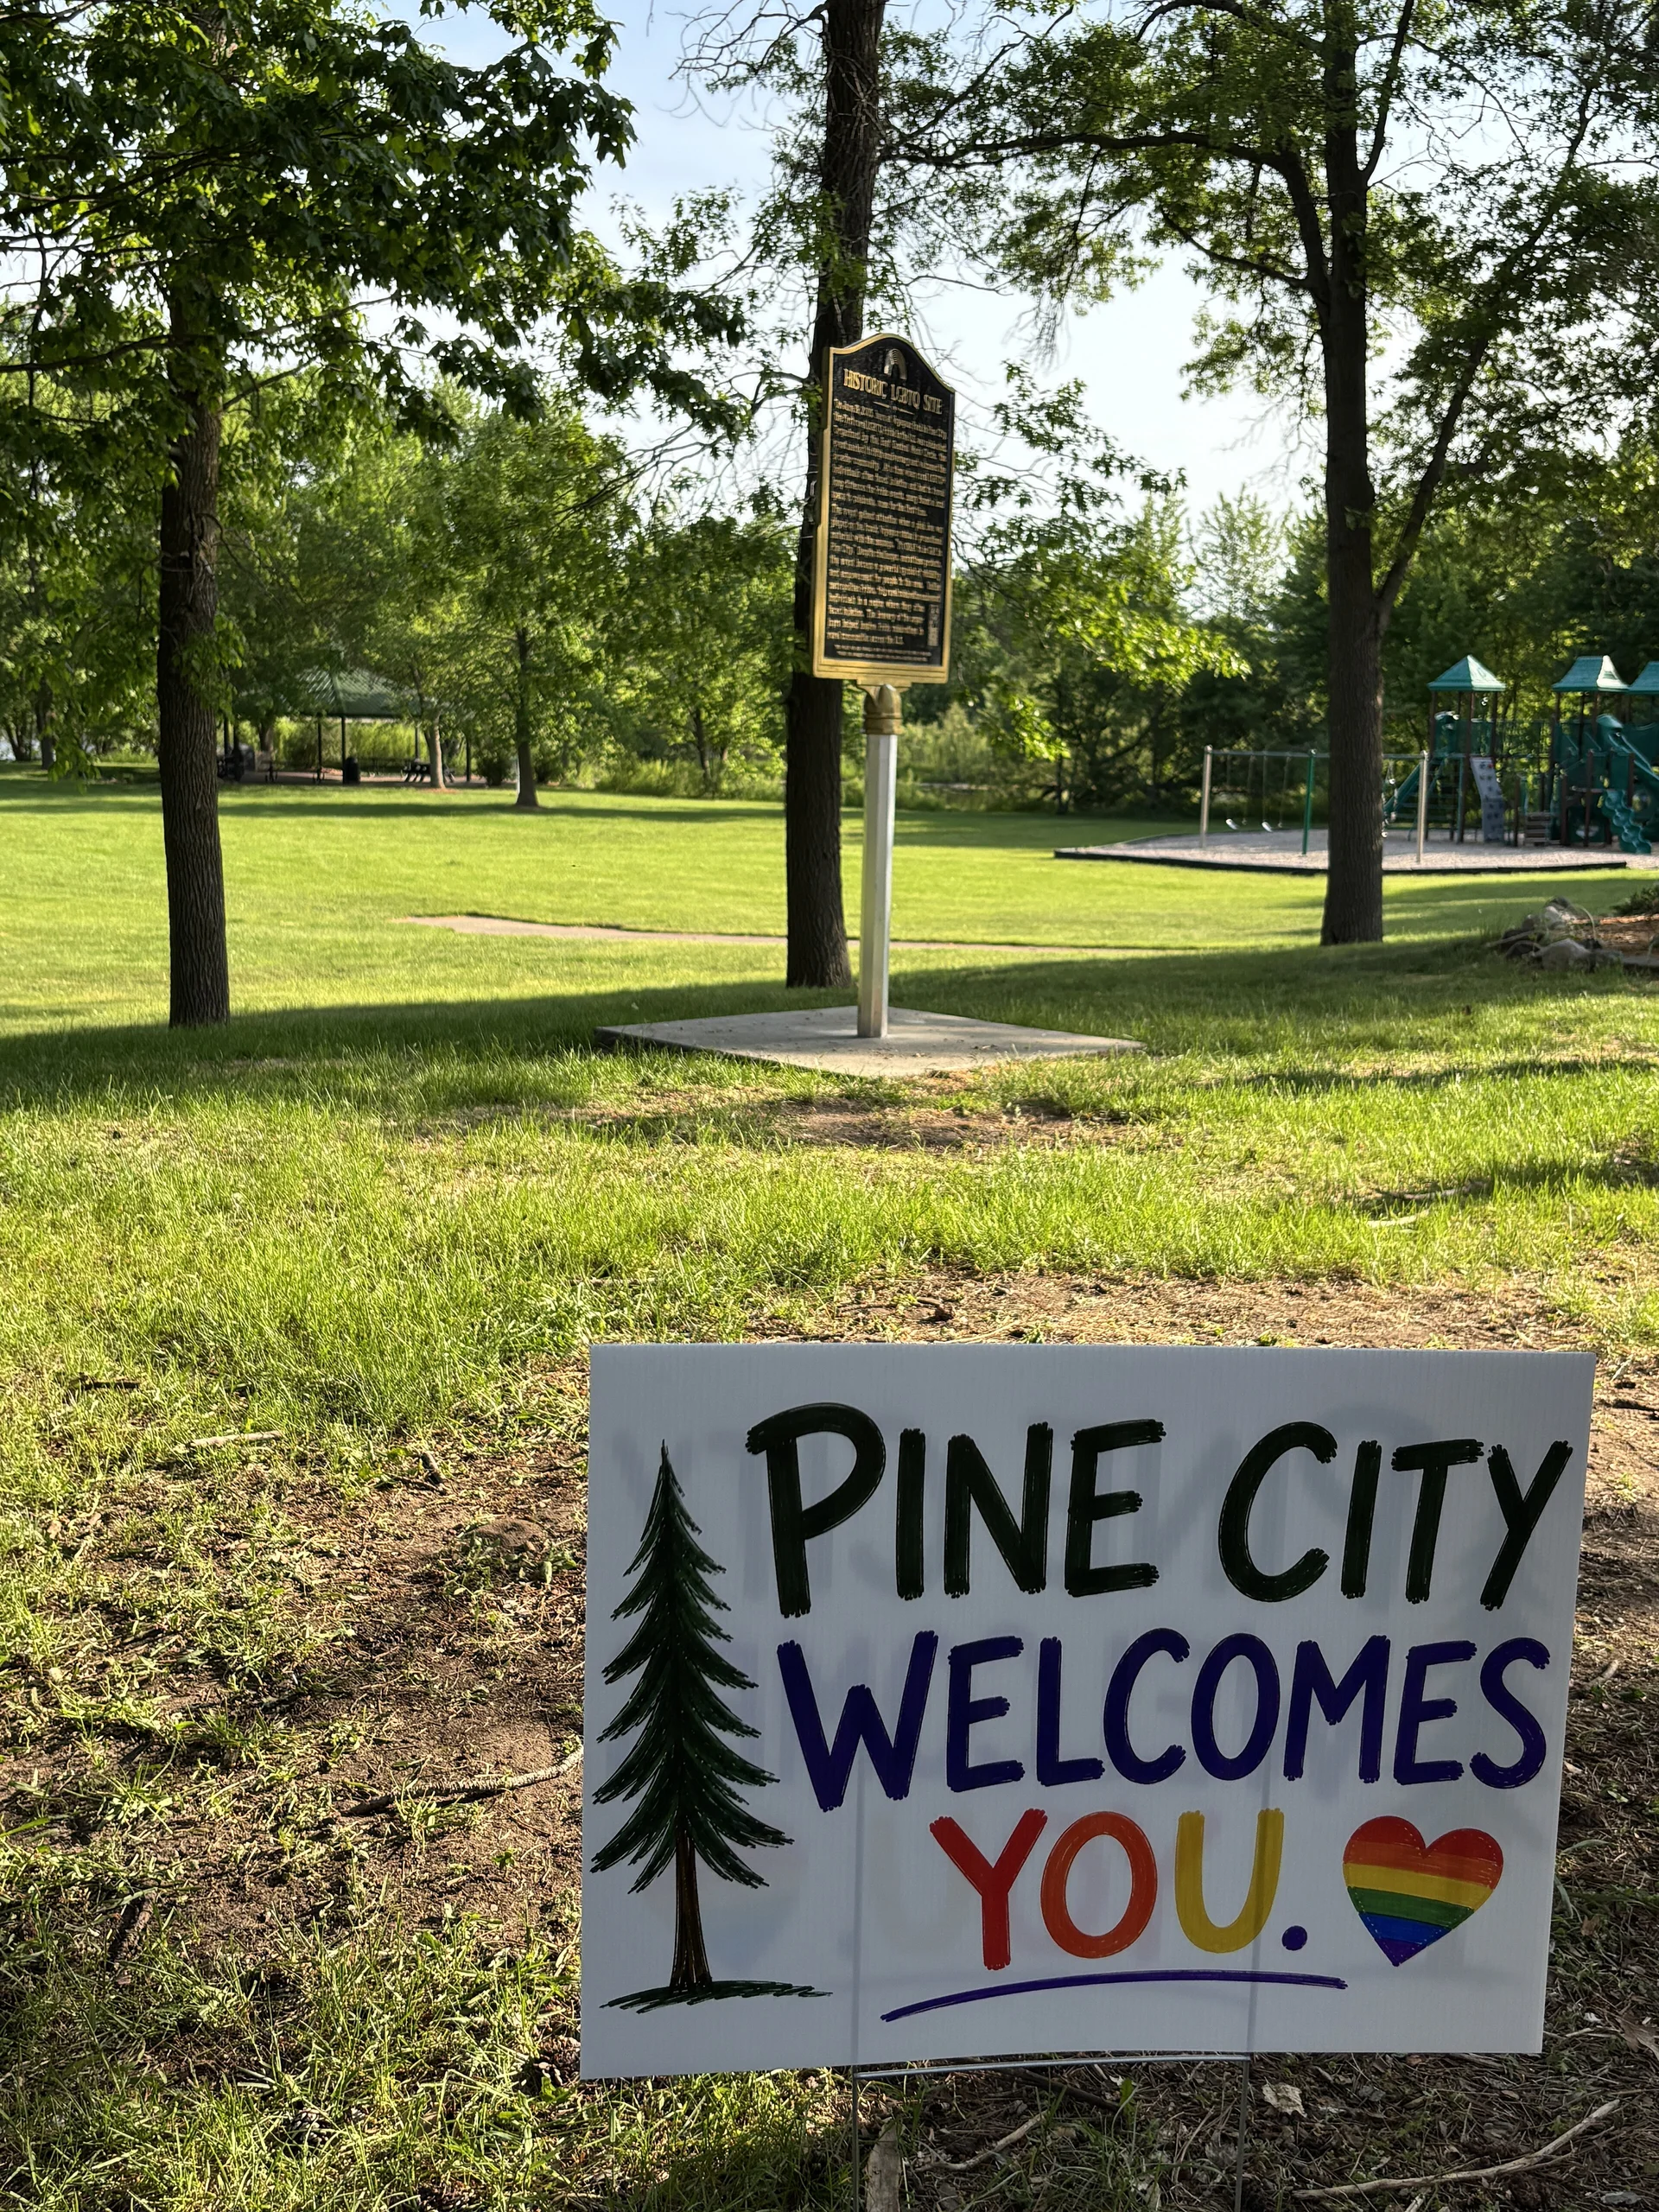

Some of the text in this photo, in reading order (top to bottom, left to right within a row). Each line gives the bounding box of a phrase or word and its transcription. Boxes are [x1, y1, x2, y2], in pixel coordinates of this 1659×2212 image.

[844, 369, 887, 398] HISTORIC
[924, 395, 942, 414] SITE
[747, 1402, 1573, 1618] PINE CITY
[778, 1629, 1549, 1812] WELCOMES
[929, 1808, 1308, 1970] YOU.
